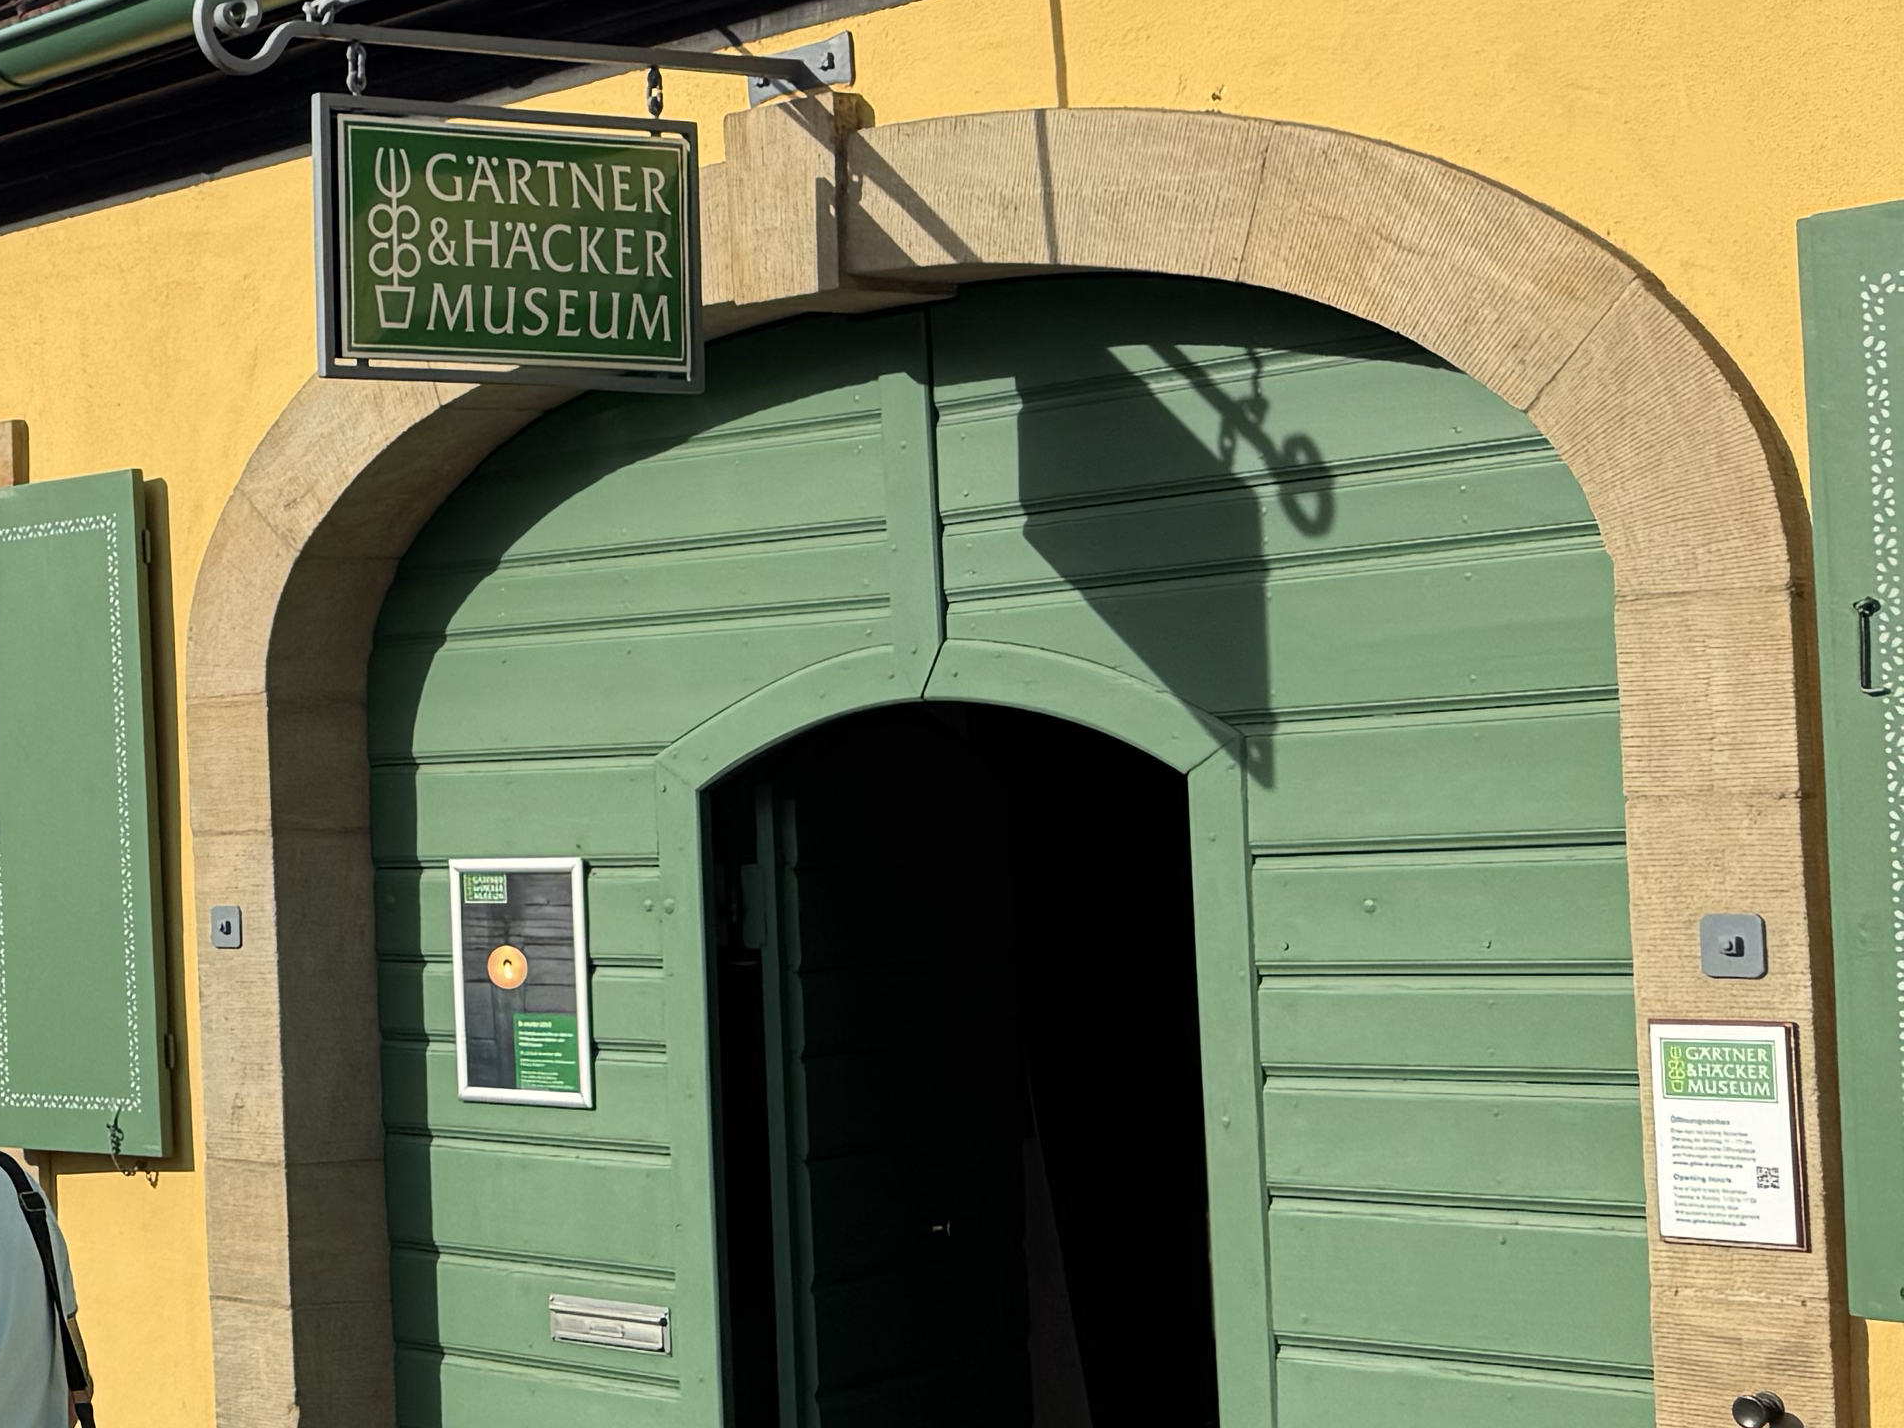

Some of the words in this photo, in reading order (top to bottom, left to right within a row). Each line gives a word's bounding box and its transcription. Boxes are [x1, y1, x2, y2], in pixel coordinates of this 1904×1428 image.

[424, 152, 672, 216] GÄRTNER
[425, 282, 672, 342] MUSEUM
[1685, 1046, 1769, 1063] GÄRTNER
[1687, 1080, 1771, 1097] MUSEUM
